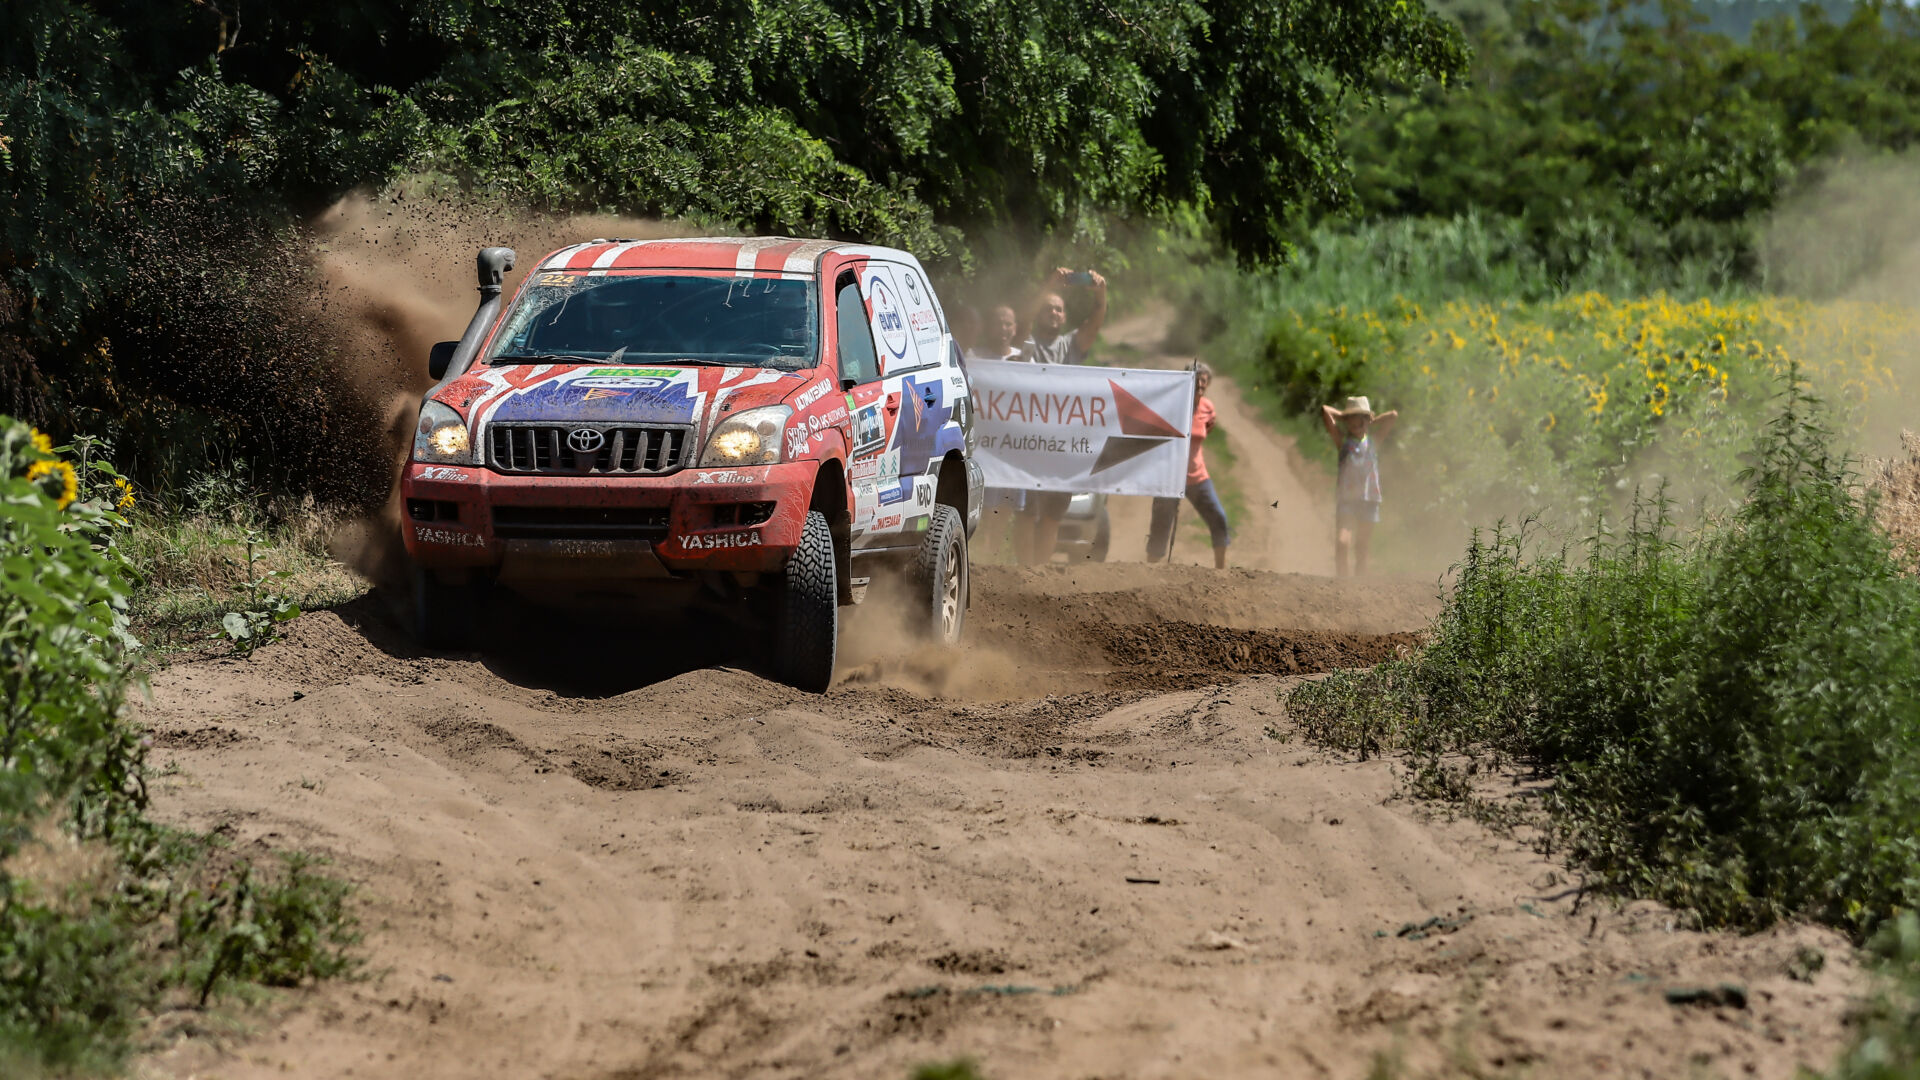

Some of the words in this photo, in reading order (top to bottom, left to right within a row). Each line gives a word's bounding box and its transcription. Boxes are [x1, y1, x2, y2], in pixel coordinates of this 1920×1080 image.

[541, 274, 575, 284] 224
[878, 303, 902, 332] eurol
[1000, 433, 1066, 453] Autóház
[1071, 436, 1093, 454] kft.
[915, 483, 932, 508] NEXO
[415, 526, 487, 548] YASHICA
[678, 531, 762, 550] YASHICA
